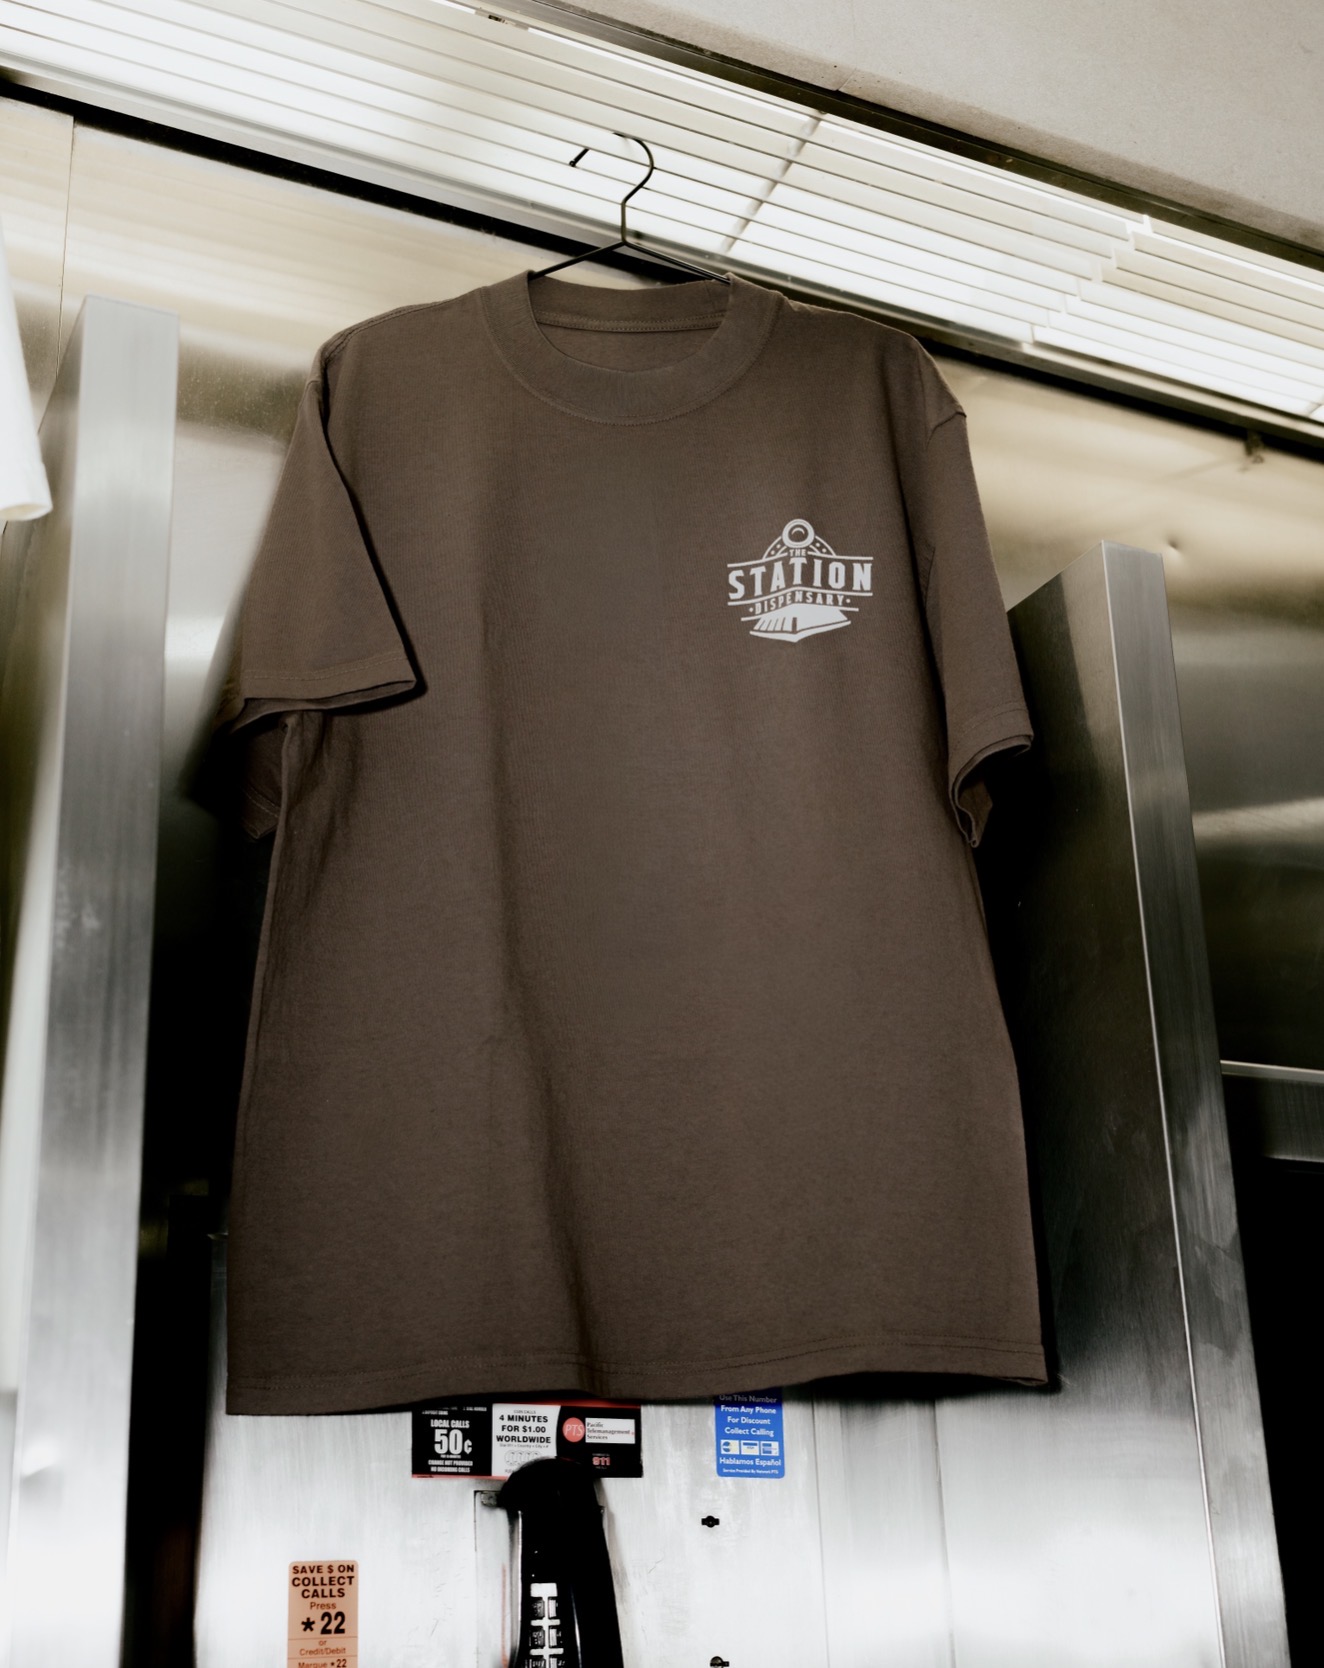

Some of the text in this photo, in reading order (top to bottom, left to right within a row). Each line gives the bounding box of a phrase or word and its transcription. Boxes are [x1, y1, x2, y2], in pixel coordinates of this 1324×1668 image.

[789, 548, 807, 557] THE
[728, 557, 873, 600] STATION
[754, 590, 845, 615] DISPENSARY
[733, 1394, 748, 1402] This
[749, 1395, 777, 1403] Number
[720, 1405, 777, 1415] From Any Phone
[430, 1418, 470, 1428] LOCAL CALLS
[507, 1414, 549, 1423] MINUTES
[741, 1417, 771, 1425] Discount
[501, 1424, 546, 1433] FOR $1.00
[565, 1424, 584, 1436] PTS
[724, 1427, 775, 1437] Collect Calling
[496, 1435, 551, 1444] WORLDWIDE
[719, 1457, 782, 1467] Hablamos Español
[292, 1564, 355, 1574] SAVE $ ON
[291, 1576, 355, 1587] COLLECT
[301, 1588, 346, 1599] CALLS
[309, 1602, 337, 1610] Press
[299, 1647, 347, 1656] Credit/Debit
